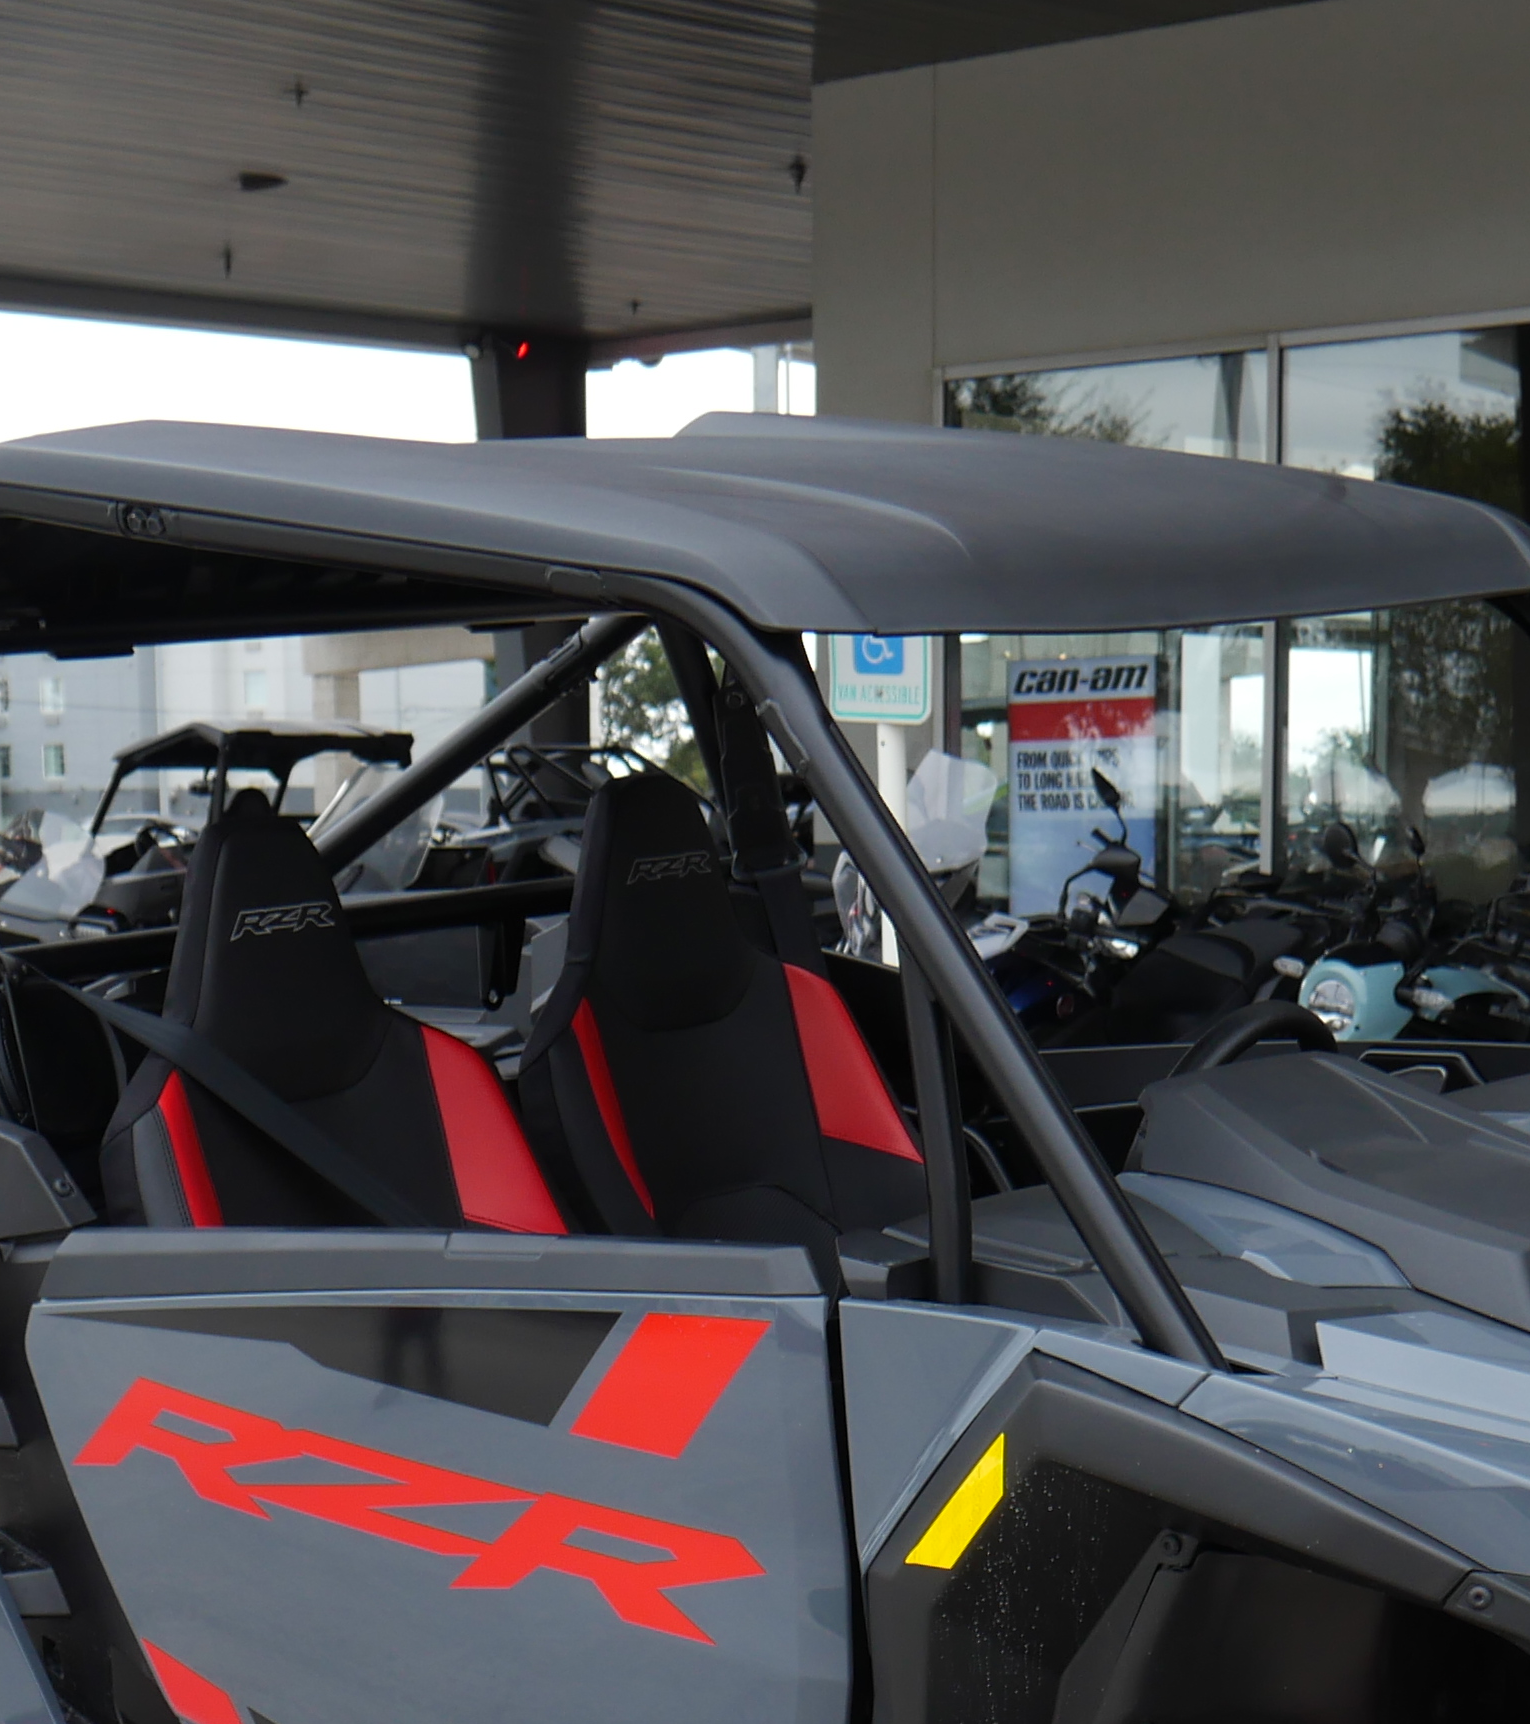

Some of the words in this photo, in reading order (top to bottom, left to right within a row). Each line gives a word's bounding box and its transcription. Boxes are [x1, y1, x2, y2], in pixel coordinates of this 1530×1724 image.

[1013, 662, 1149, 695] can-am
[837, 684, 857, 701] VAN
[1017, 750, 1047, 769] FROM
[1018, 772, 1031, 790] TO
[1034, 771, 1063, 790] LONG
[1018, 792, 1036, 811] THE
[1040, 791, 1070, 811] ROAD
[1073, 791, 1084, 810] IS
[626, 852, 711, 885] RZR
[230, 902, 336, 942] RZR
[72, 1376, 767, 1646] RZR
